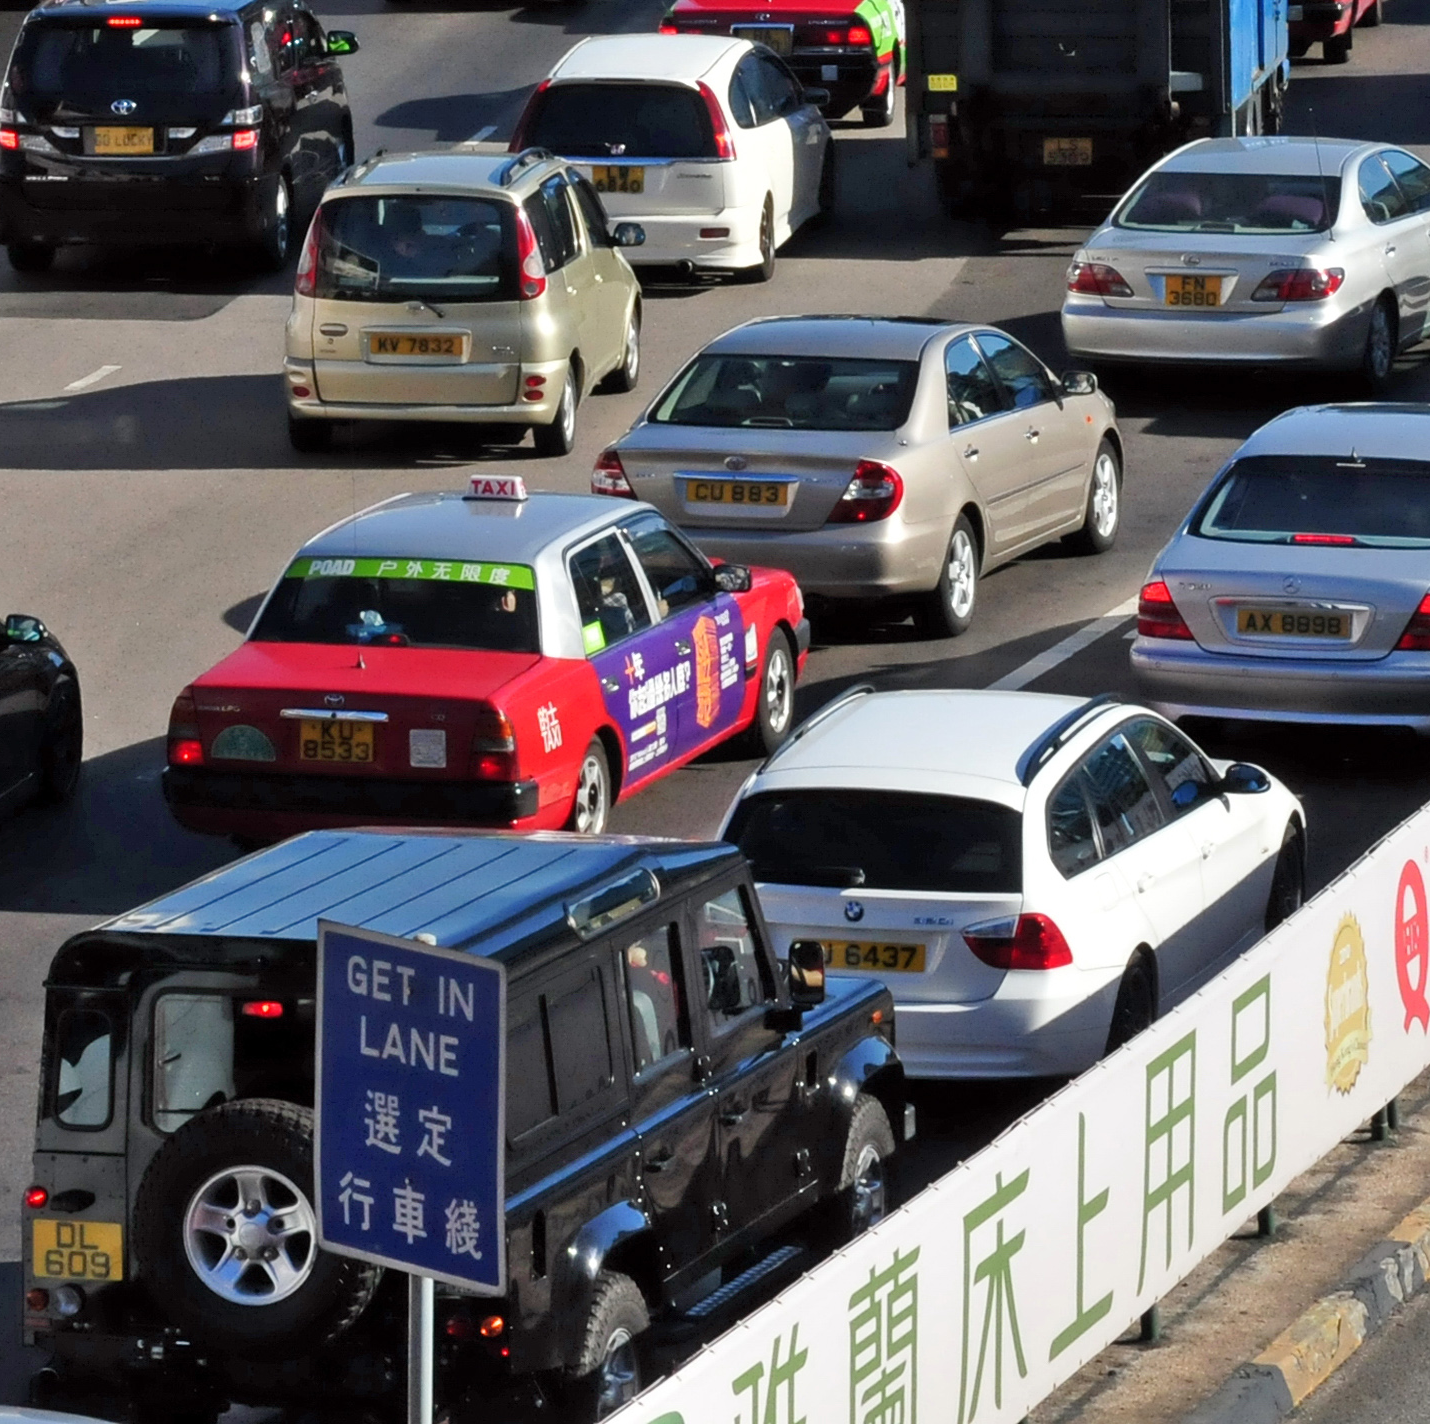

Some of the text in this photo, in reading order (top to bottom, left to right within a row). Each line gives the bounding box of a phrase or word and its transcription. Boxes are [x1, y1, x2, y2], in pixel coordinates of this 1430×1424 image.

[1179, 275, 1204, 290] FN
[1167, 291, 1217, 306] 3680
[377, 335, 454, 353] KV 7832
[470, 479, 516, 495] TAXI
[695, 485, 779, 503] CU 883
[308, 559, 356, 577] POAD
[1245, 614, 1273, 631] AX
[321, 722, 354, 740] KU
[540, 723, 563, 753] TAXI
[304, 739, 371, 760] 8533
[843, 947, 919, 971] 6437
[347, 955, 476, 1022] GET IN
[359, 1014, 460, 1077] LANE
[364, 1090, 453, 1167] 選定
[55, 1220, 100, 1250] DL
[44, 1250, 111, 1279] 609
